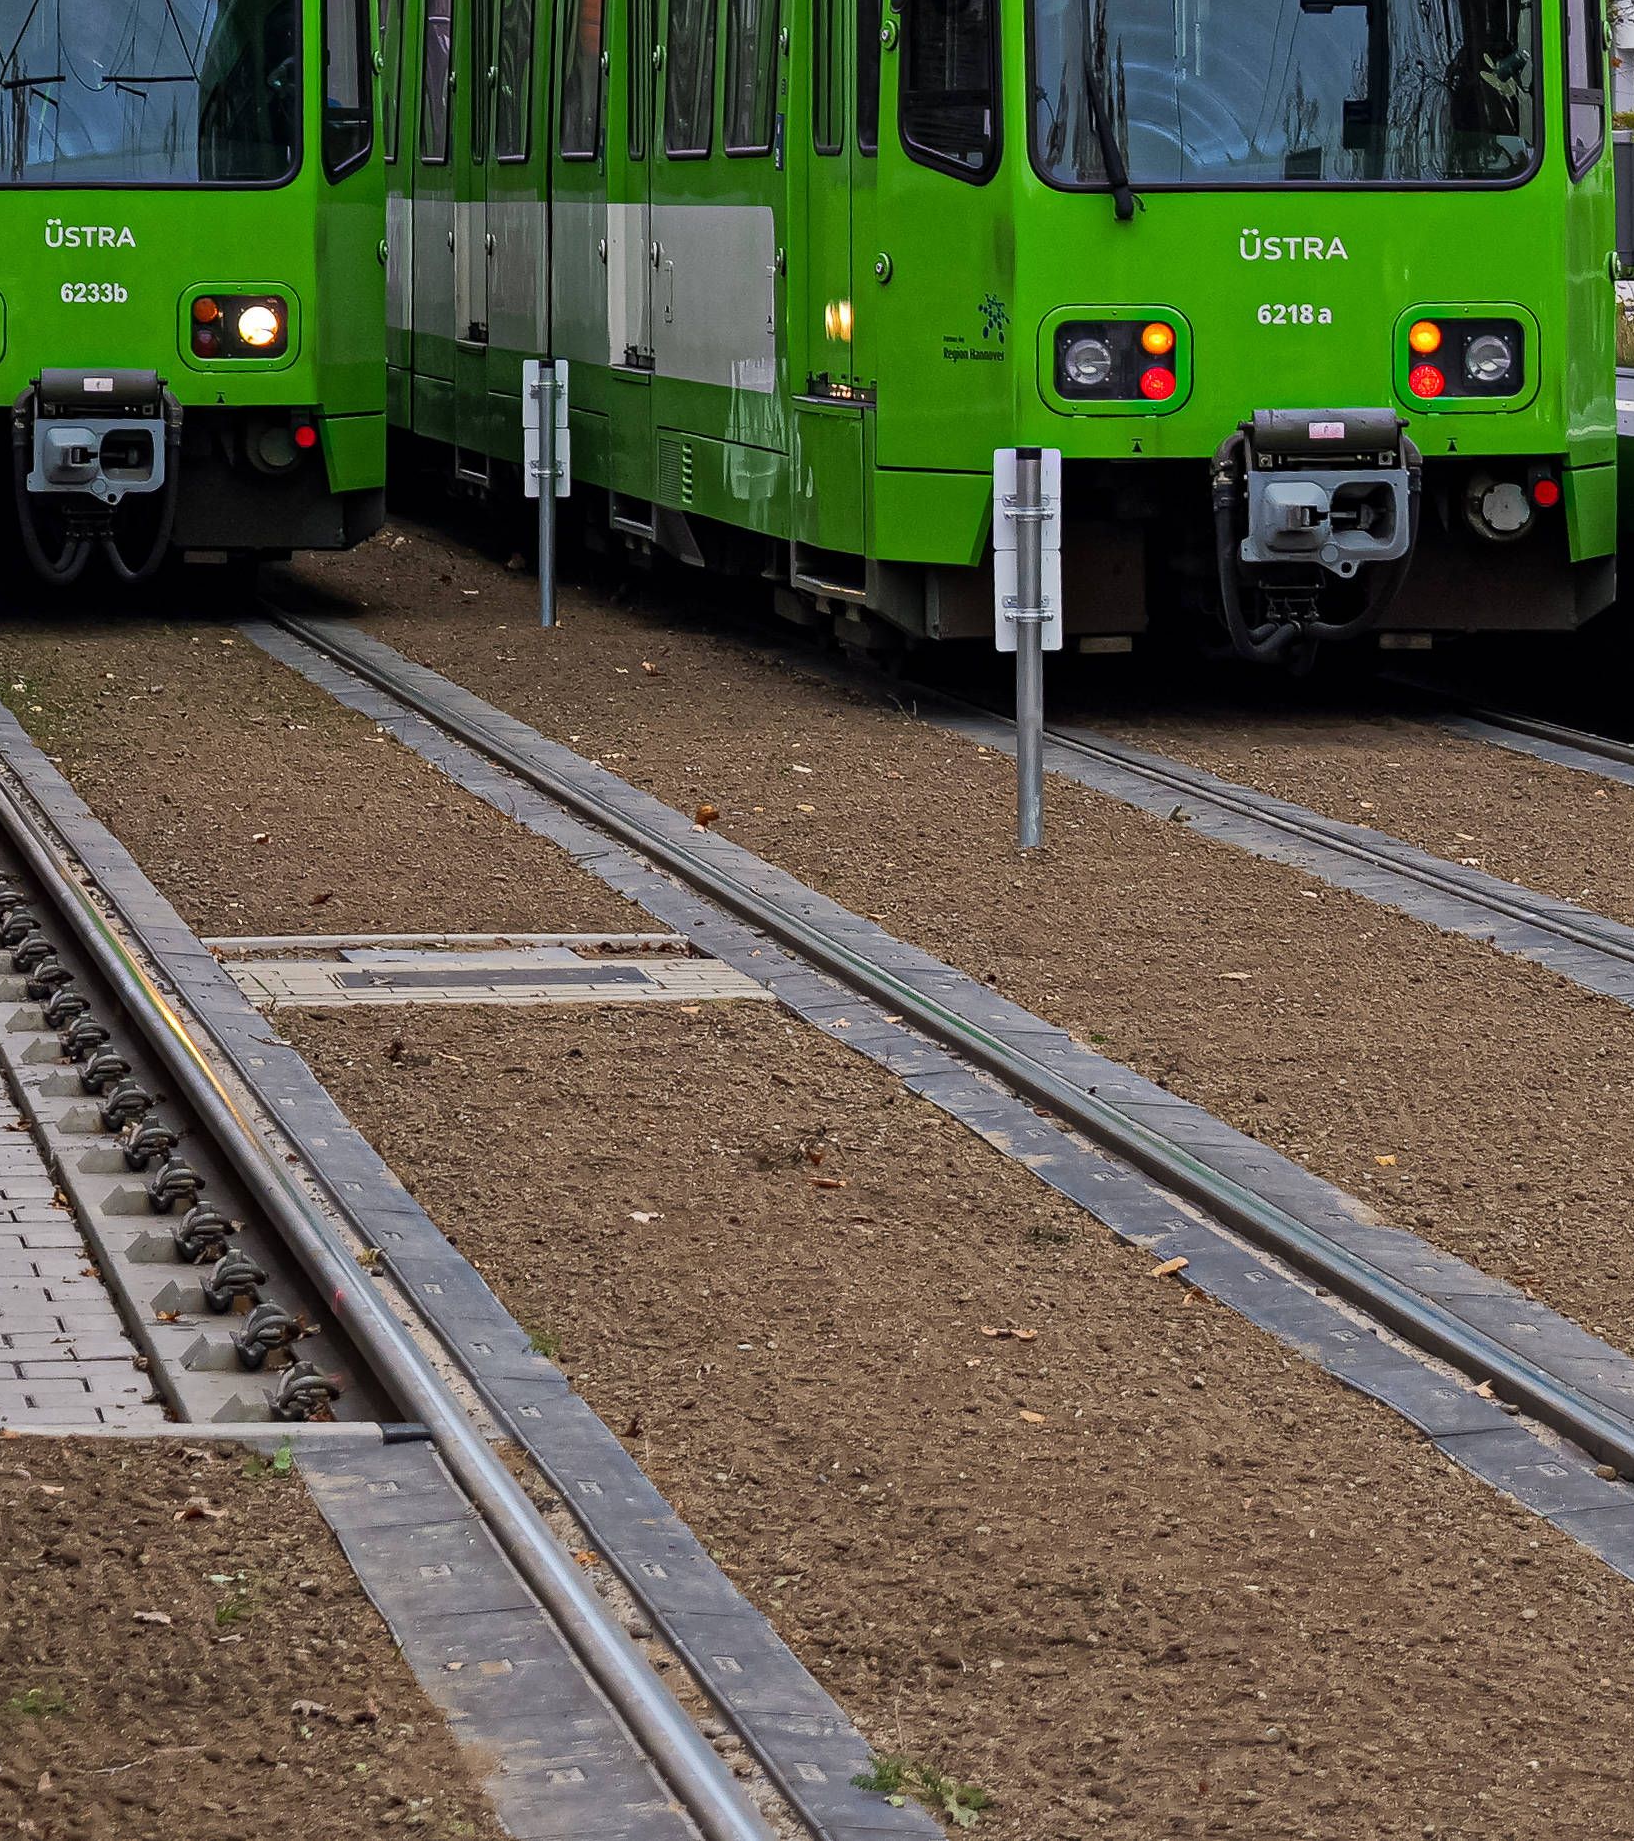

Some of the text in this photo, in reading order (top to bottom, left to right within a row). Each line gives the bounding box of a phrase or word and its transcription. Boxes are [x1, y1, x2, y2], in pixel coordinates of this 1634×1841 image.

[45, 218, 137, 248] ÜSTRA
[1239, 228, 1349, 261] ÜSTRA
[60, 282, 128, 303] 6233b
